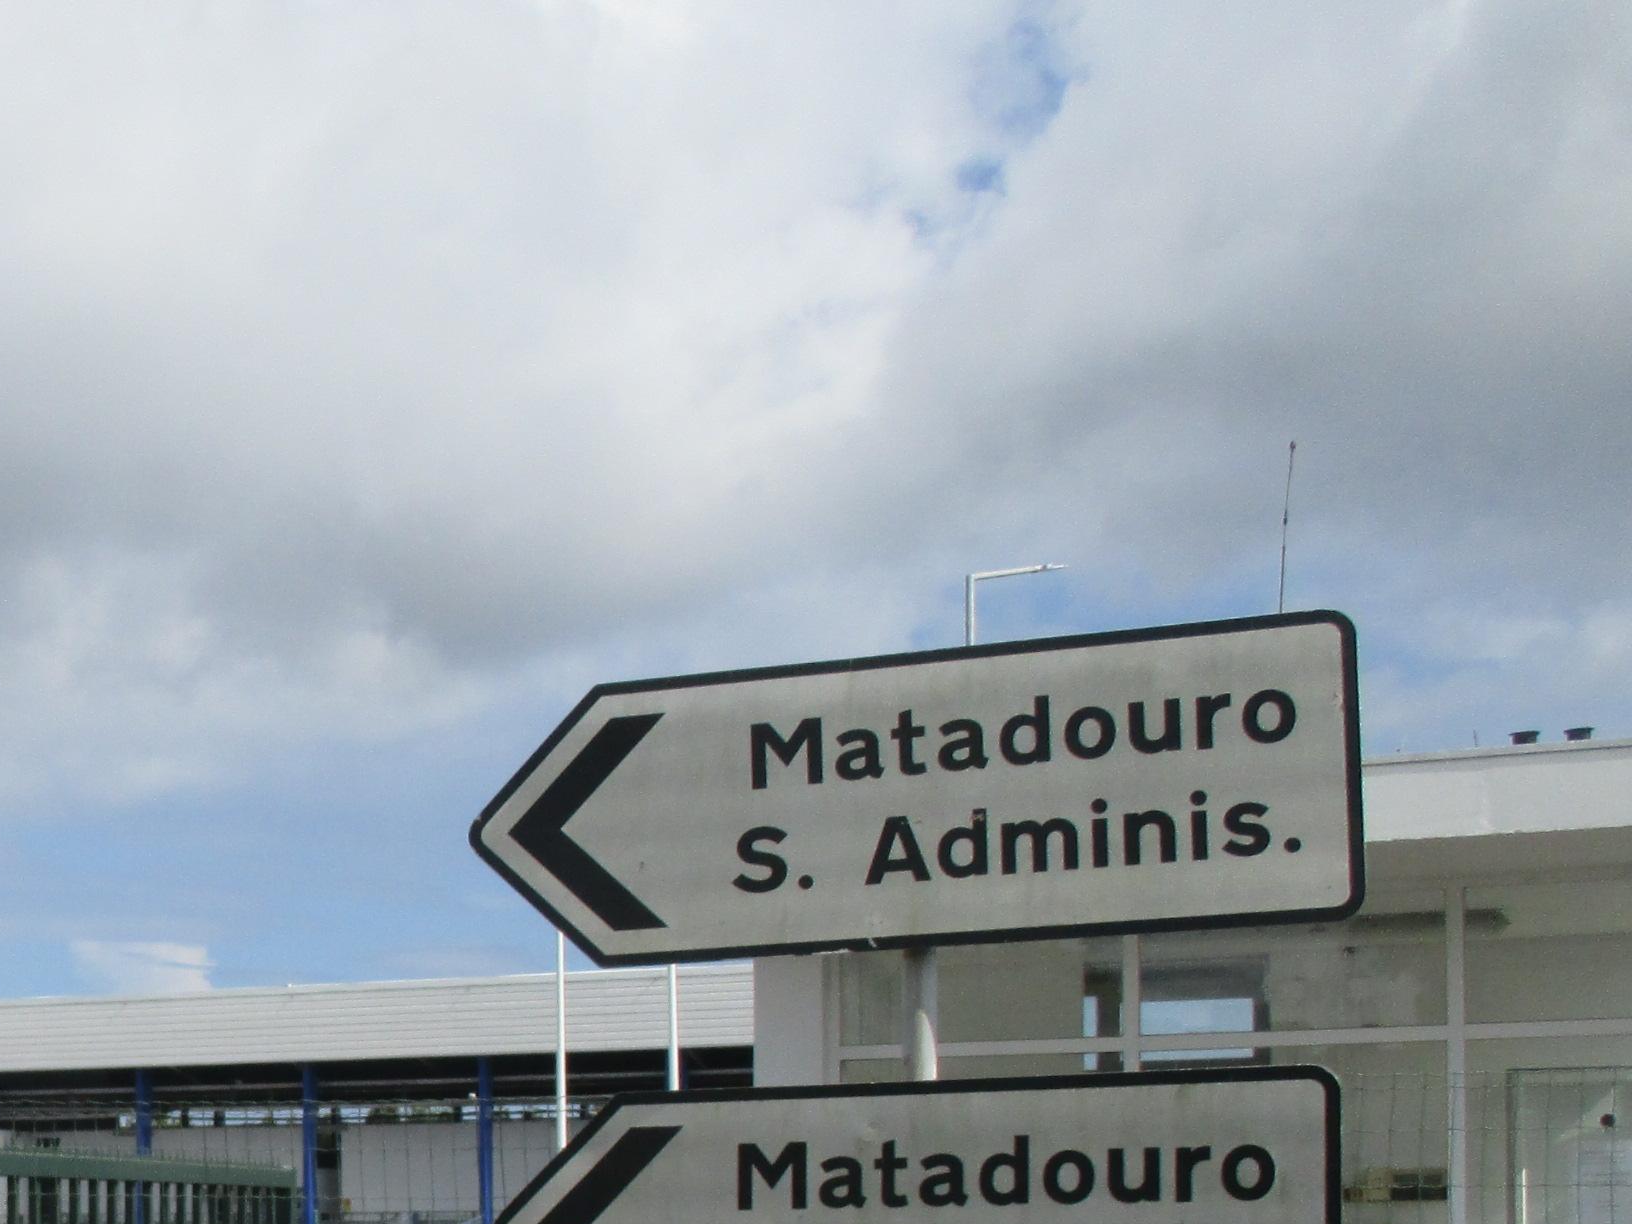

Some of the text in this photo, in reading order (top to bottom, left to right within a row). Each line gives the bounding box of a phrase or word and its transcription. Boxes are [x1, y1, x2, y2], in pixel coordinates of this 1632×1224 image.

[751, 689, 1297, 789] Matadouro
[732, 790, 1302, 894] S. Adminis.
[738, 1135, 1276, 1210] Matadouro
